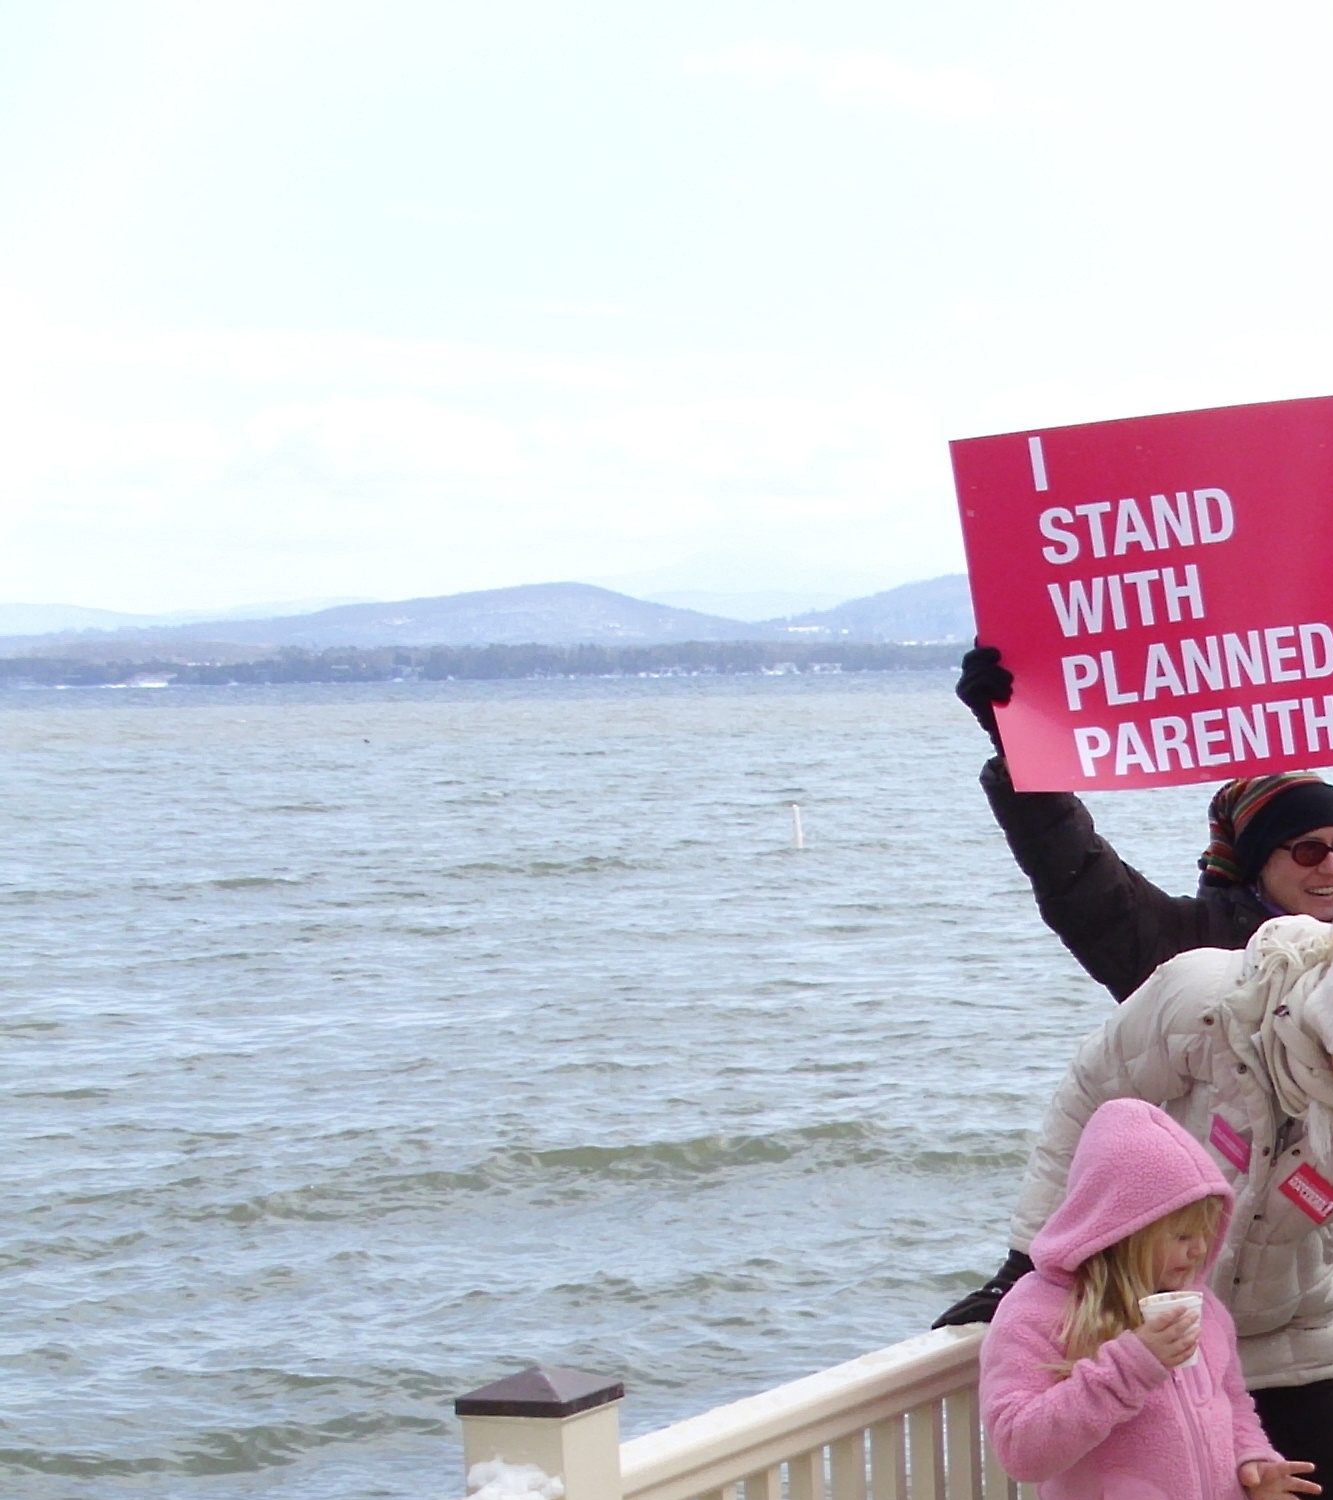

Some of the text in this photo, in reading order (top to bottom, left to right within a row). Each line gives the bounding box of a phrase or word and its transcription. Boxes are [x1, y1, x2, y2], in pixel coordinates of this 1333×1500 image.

[1028, 436, 1048, 491] I
[1038, 488, 1234, 565] STAND
[1047, 564, 1205, 638] WITH
